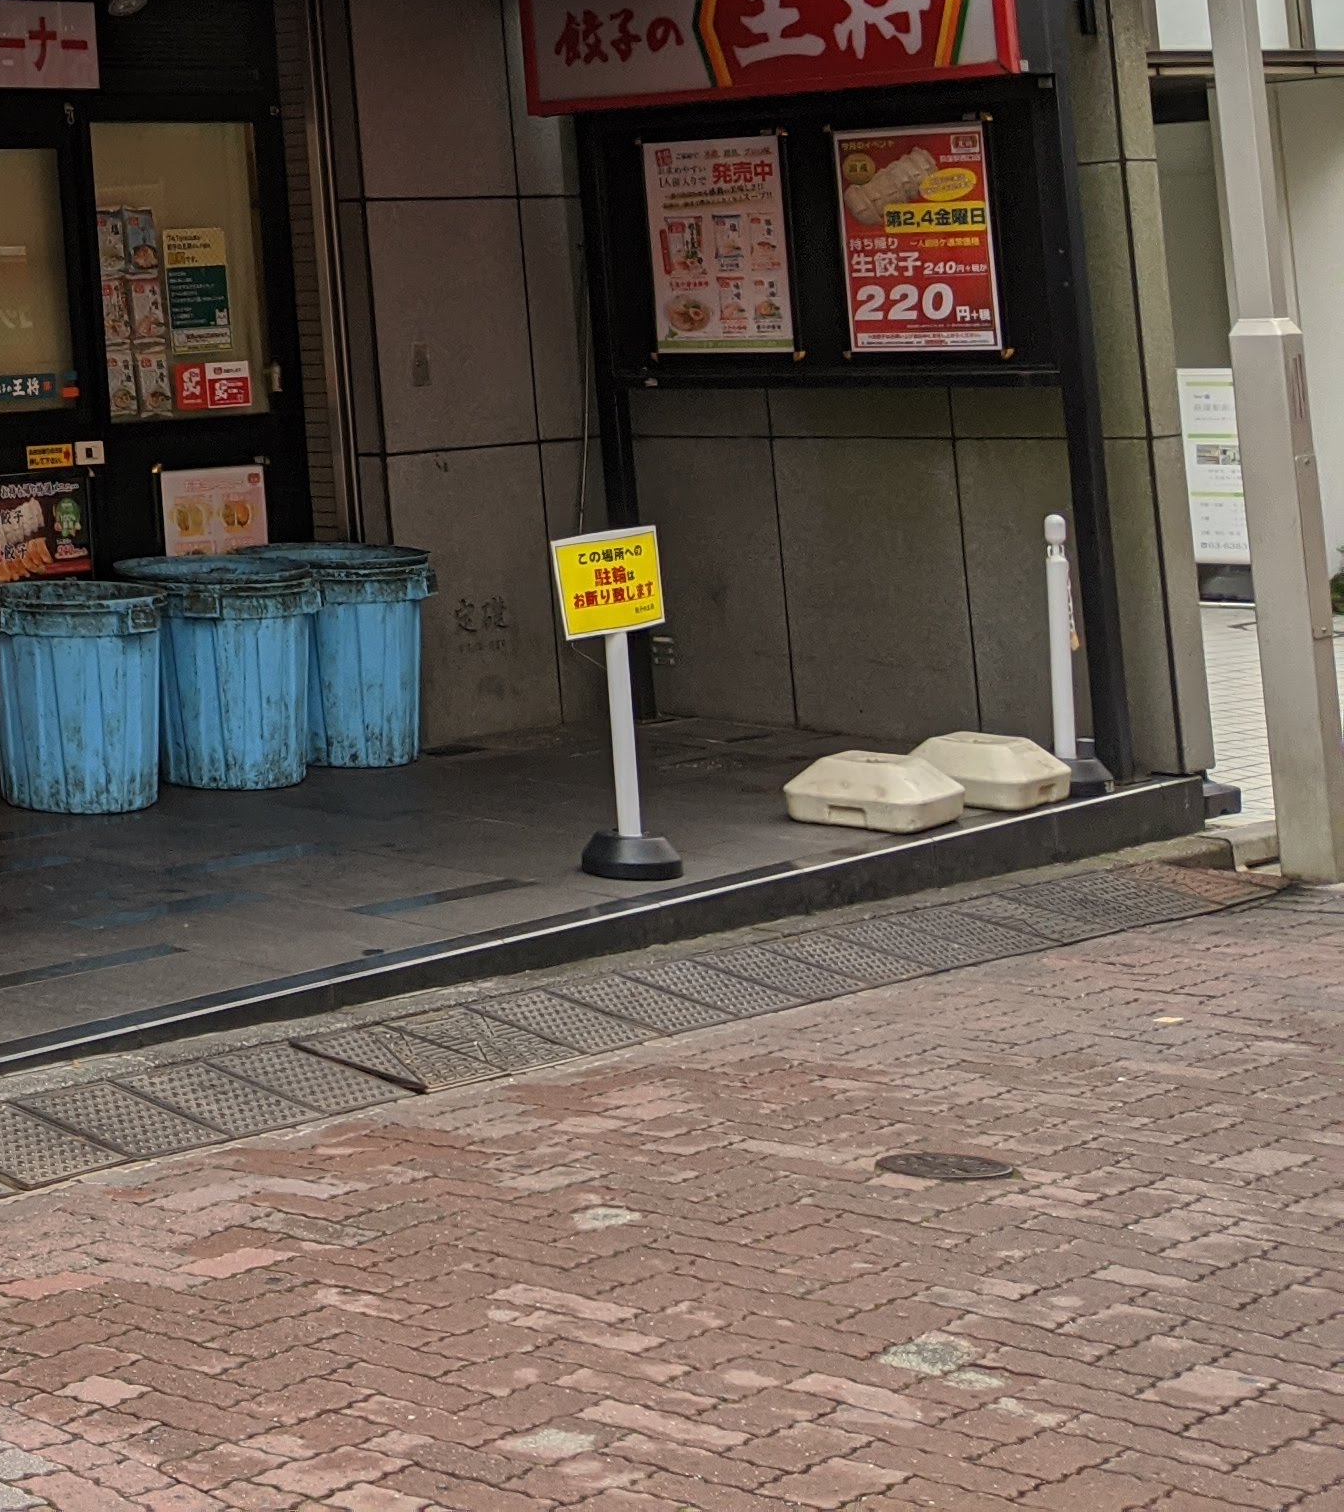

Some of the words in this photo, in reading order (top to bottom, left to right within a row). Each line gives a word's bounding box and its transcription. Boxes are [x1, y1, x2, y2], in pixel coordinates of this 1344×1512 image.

[712, 160, 774, 185] 発売中
[886, 206, 986, 228] 第2,4金曜日
[849, 238, 899, 250] 持ち帰り
[851, 251, 922, 278] 生餃子
[578, 544, 643, 565] この場所への
[594, 565, 635, 587] 駐輪は
[573, 581, 654, 608] お断り致します
